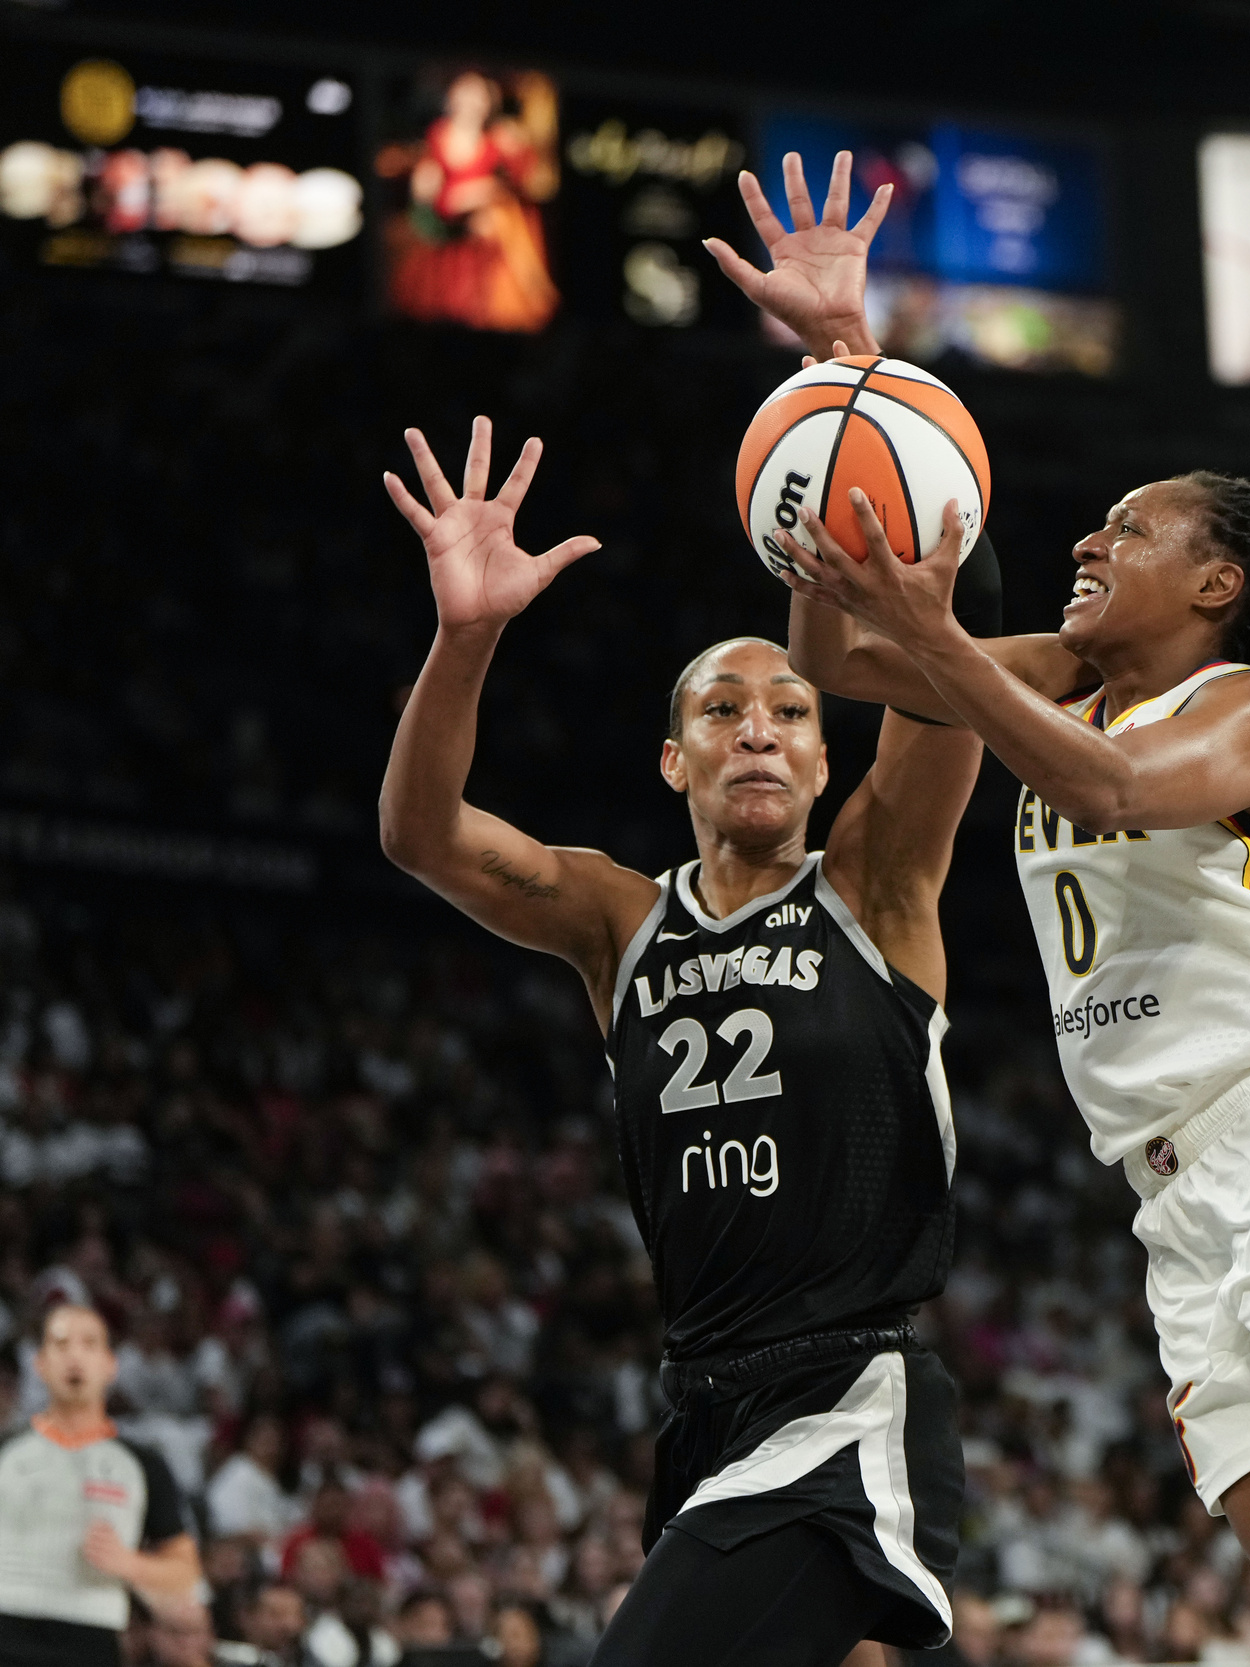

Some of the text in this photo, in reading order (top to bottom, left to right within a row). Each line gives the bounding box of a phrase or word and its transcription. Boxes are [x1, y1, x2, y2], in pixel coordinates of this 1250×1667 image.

[762, 469, 813, 588] ilon
[765, 903, 813, 929] ally
[1054, 869, 1098, 977] 0
[1054, 993, 1161, 1040] alesforce
[657, 1008, 783, 1115] 22
[682, 1130, 780, 1198] ring
